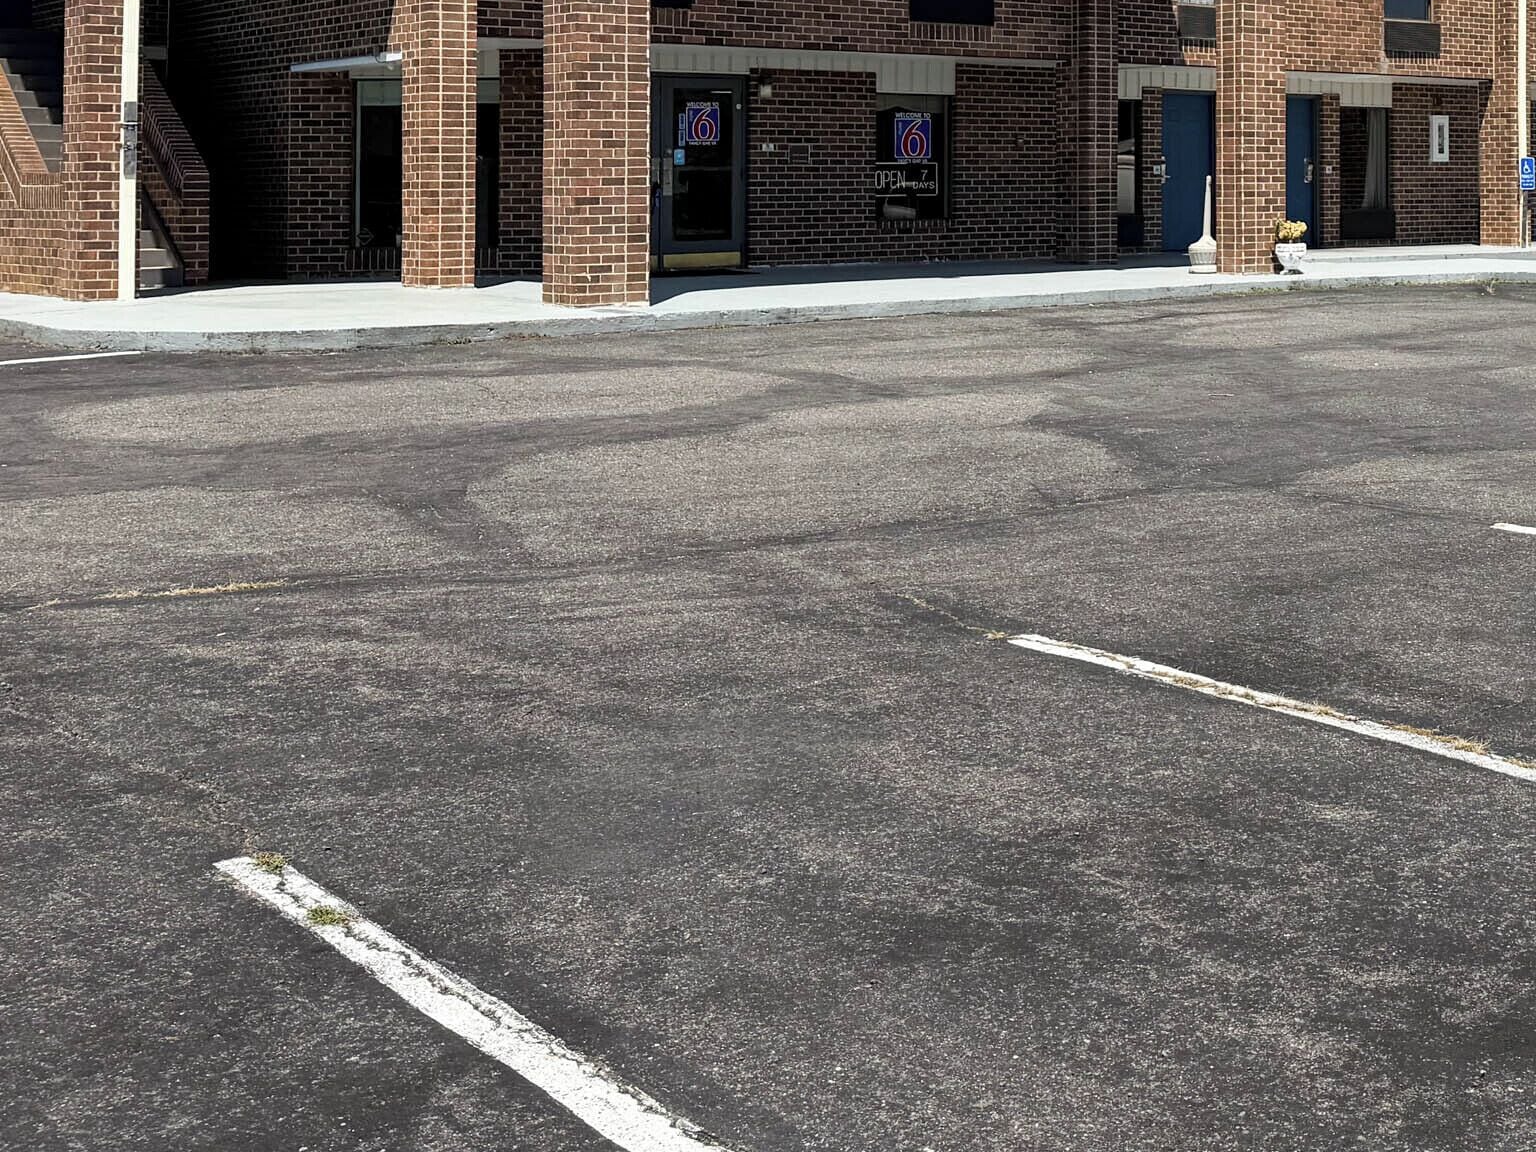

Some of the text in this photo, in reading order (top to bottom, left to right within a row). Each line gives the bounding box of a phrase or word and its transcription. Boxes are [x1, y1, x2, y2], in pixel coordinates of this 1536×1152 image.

[692, 107, 716, 141] 6
[901, 119, 927, 158] 6
[874, 170, 906, 189] OPEN
[920, 169, 928, 181] 7
[912, 181, 935, 189] DAYS
